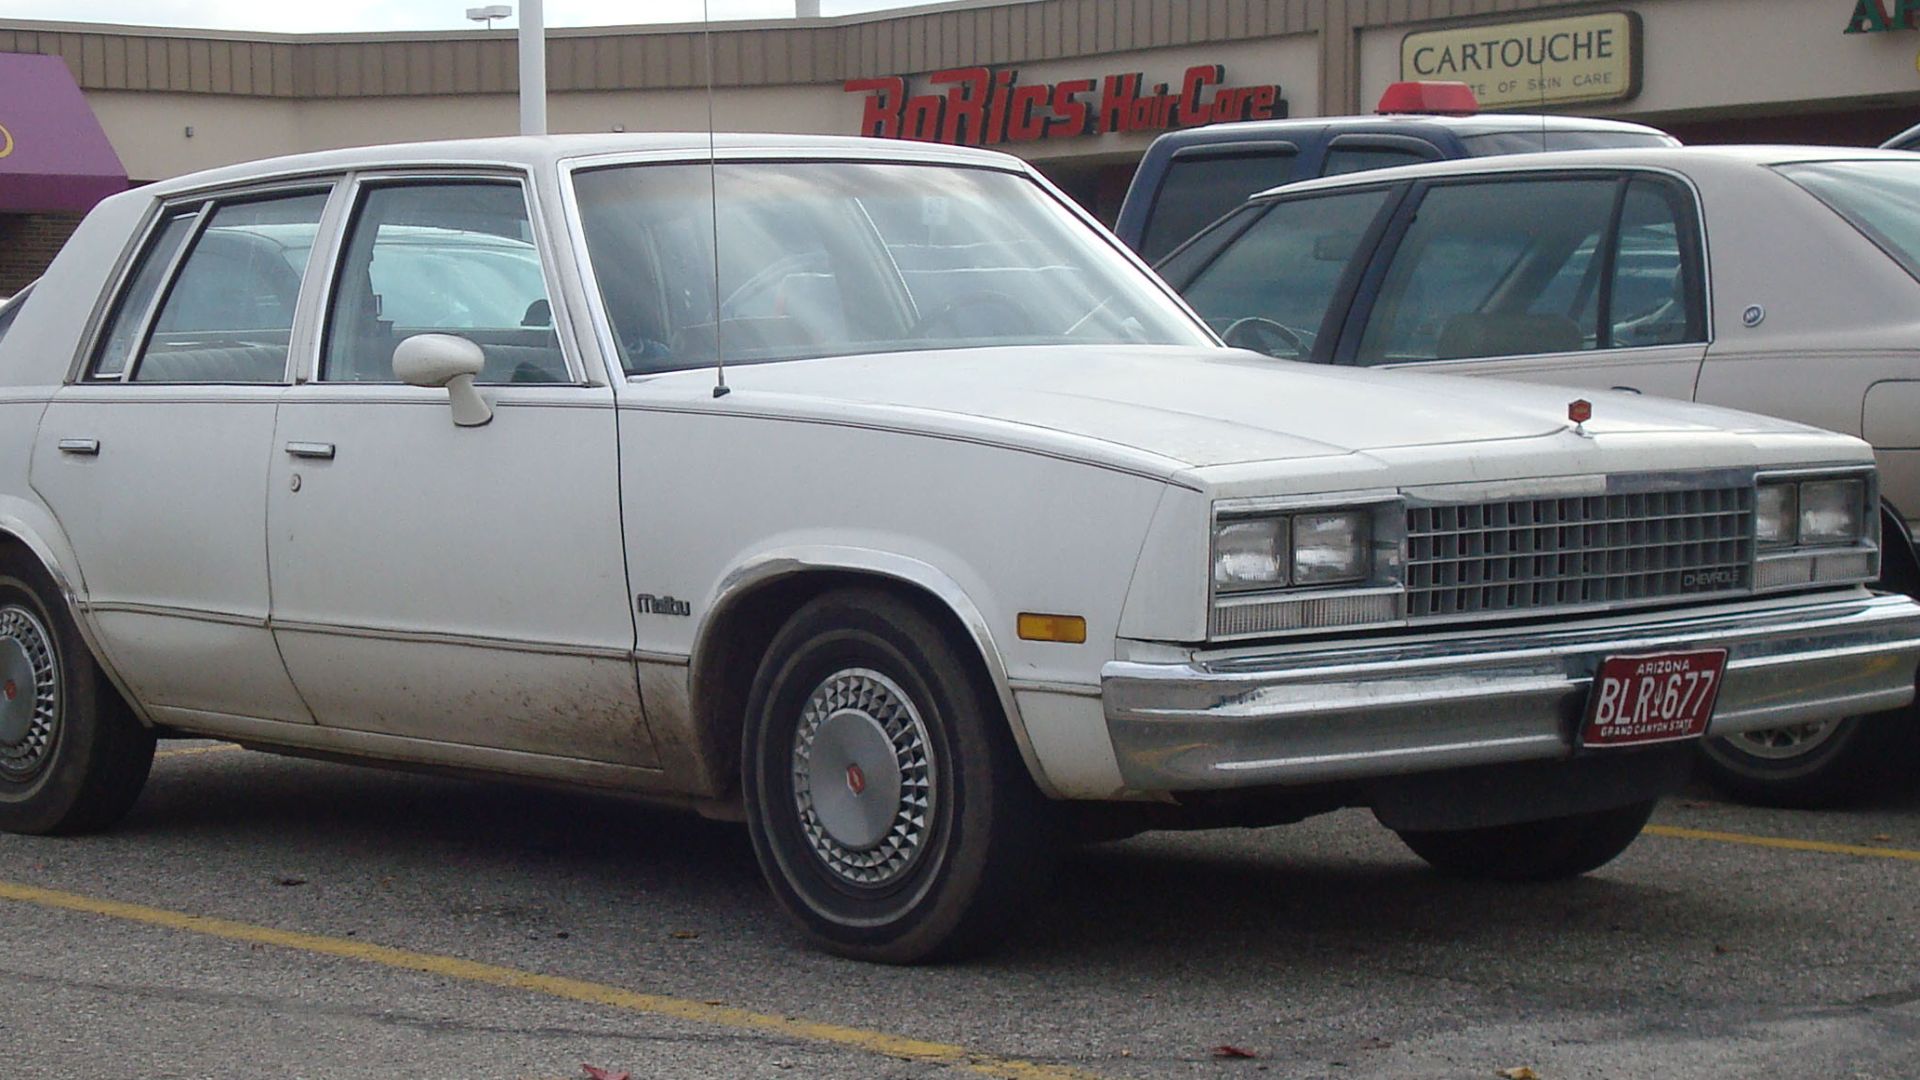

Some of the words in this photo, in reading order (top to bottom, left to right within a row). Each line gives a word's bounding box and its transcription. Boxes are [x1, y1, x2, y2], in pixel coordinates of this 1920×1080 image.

[1413, 29, 1613, 75] CARTOUCHE
[1498, 81, 1517, 93] OF
[1528, 77, 1562, 91] SKIN
[1573, 72, 1612, 87] CARE
[637, 594, 690, 616] Malibu
[1636, 659, 1690, 676] ARIZONA
[1601, 726, 1633, 737] GRAND
[1634, 722, 1668, 735] CANYON
[1669, 718, 1694, 731] STATE
